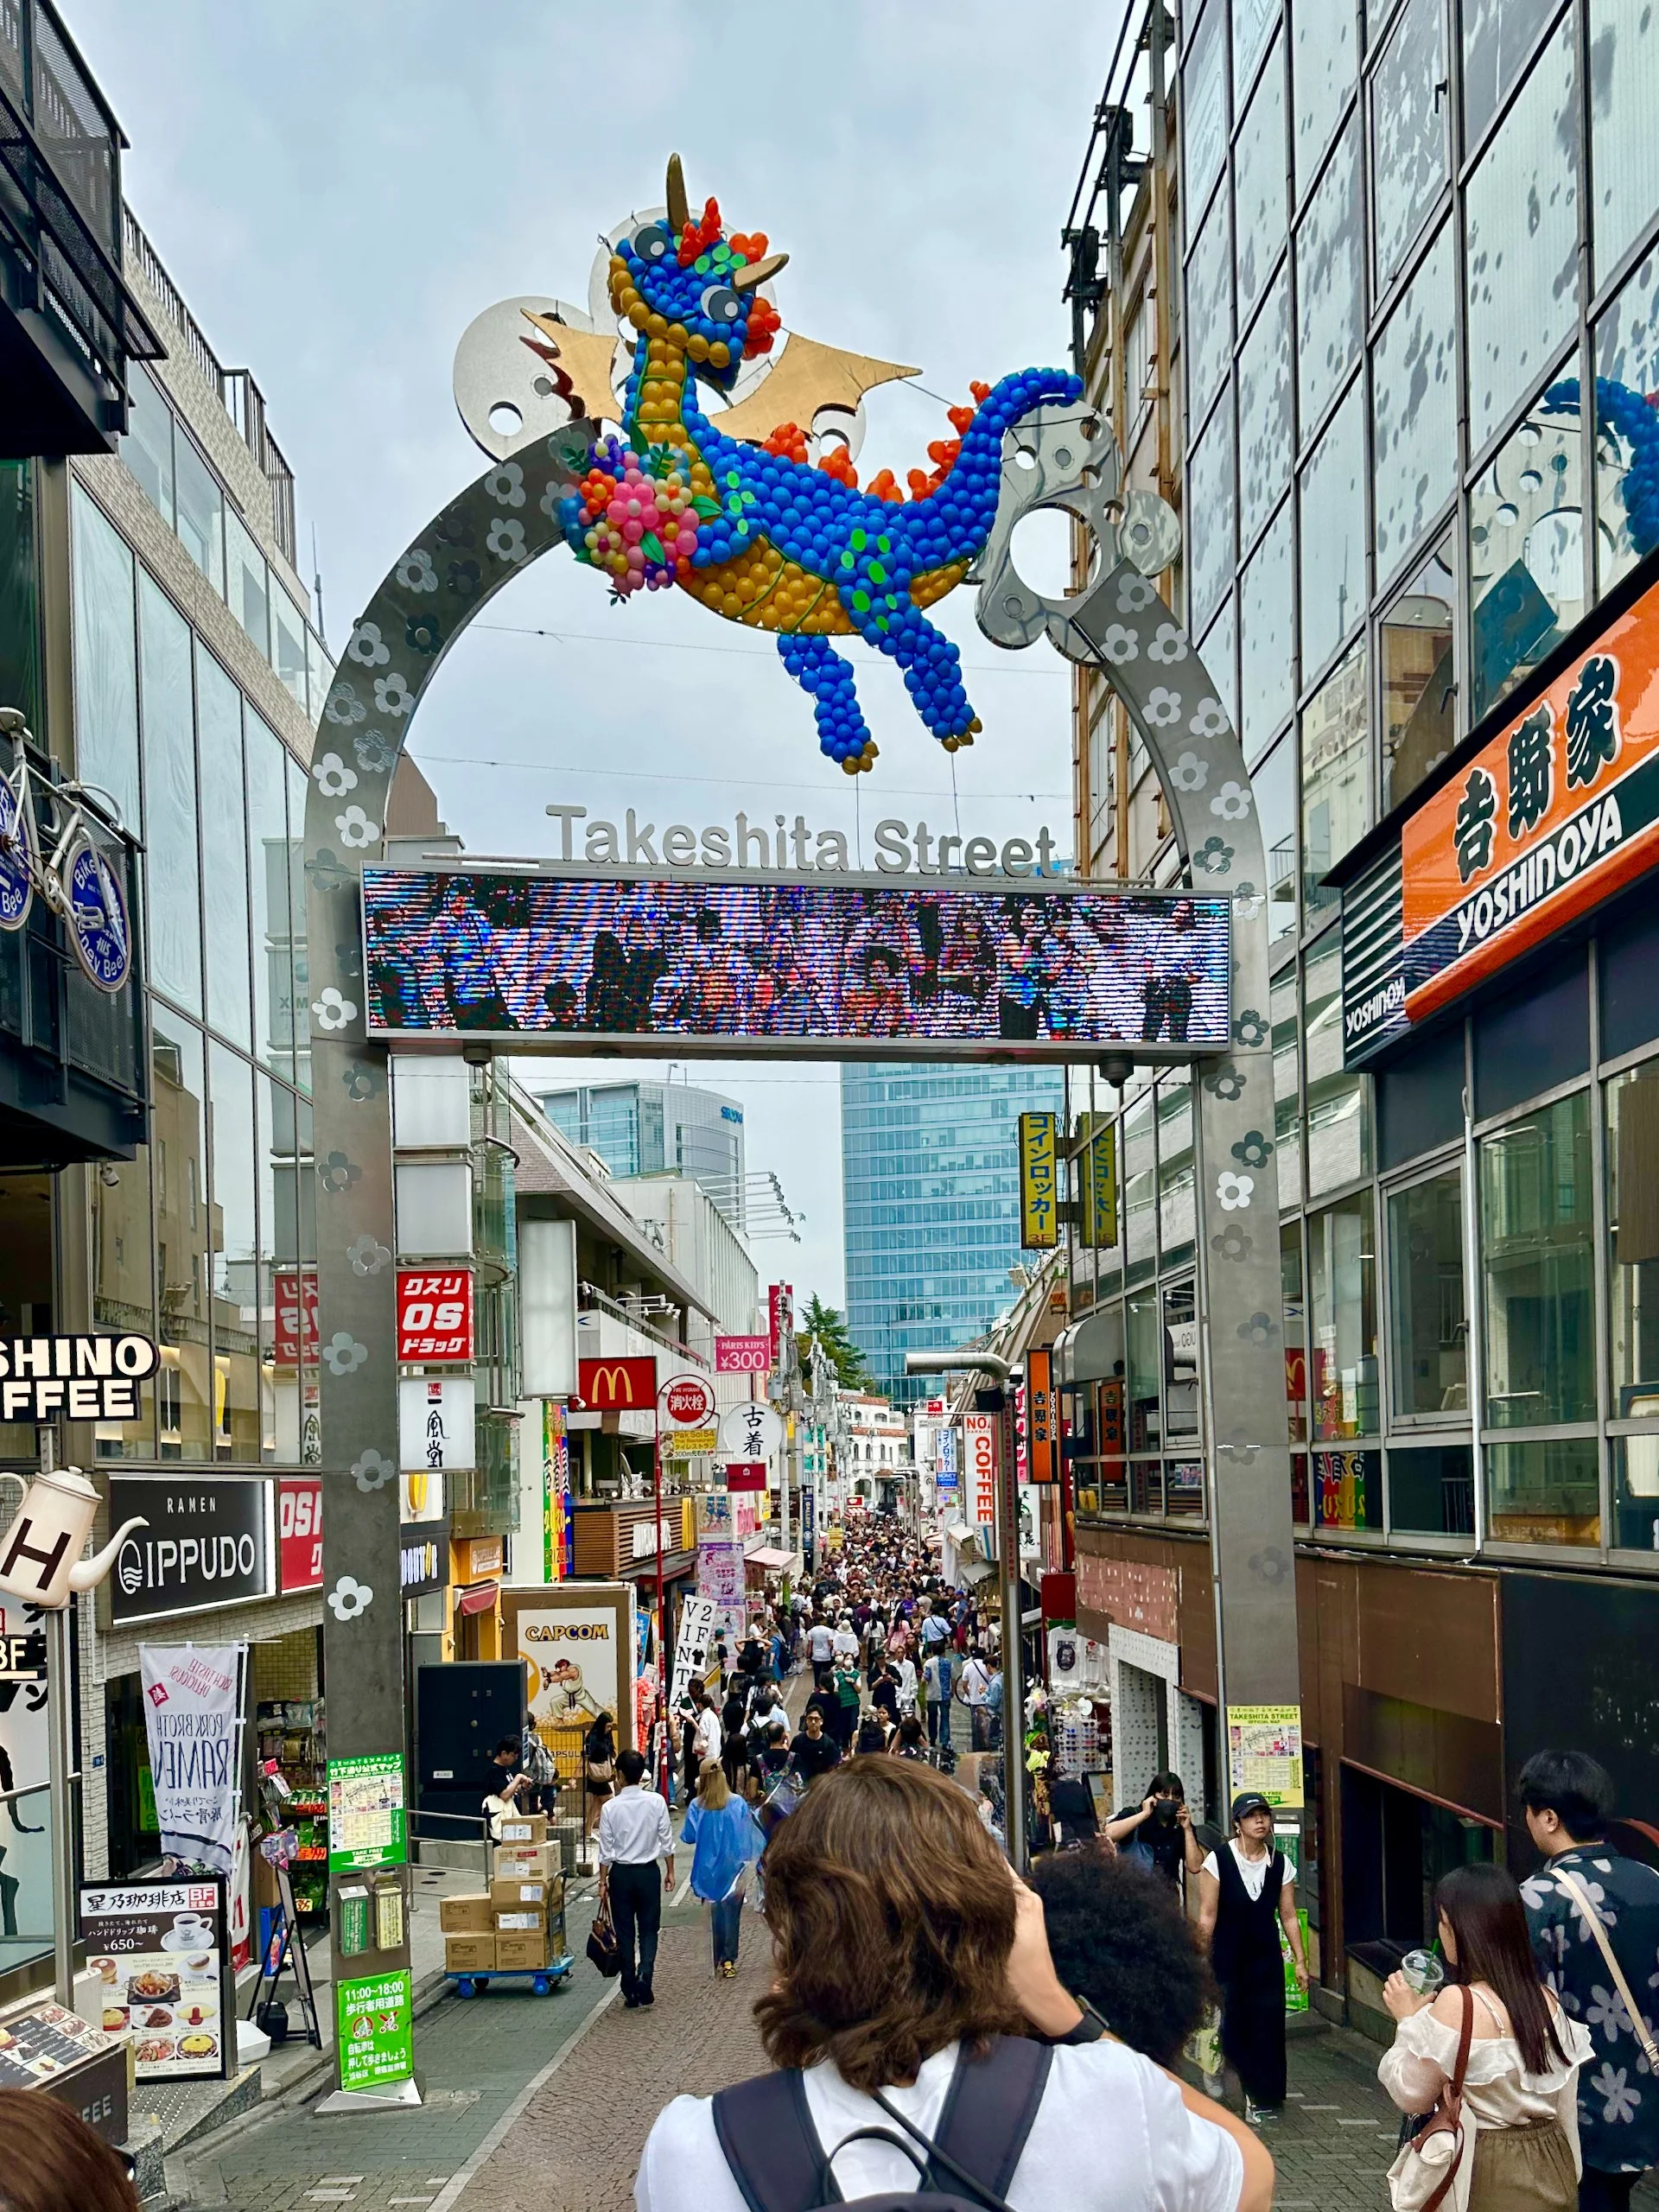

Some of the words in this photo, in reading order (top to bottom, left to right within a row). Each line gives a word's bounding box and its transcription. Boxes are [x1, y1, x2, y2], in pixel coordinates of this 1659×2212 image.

[1454, 653, 1622, 885] 吉野家
[545, 804, 849, 872] Takeshita
[874, 819, 1058, 880] Street
[1457, 793, 1624, 953] YOSHINOYA
[1027, 1116, 1052, 1230] コインロッカー
[404, 1277, 462, 1296] クスリ
[402, 1302, 465, 1331] OS
[402, 1337, 467, 1354] ドラッグ
[721, 1351, 765, 1370] ¥300
[670, 1395, 704, 1411] 消火栓
[1033, 1390, 1047, 1442] 吉野家
[426, 1398, 450, 1468] 一風堂
[742, 1406, 765, 1457] 古着
[976, 1436, 994, 1522] COFFEE
[167, 1497, 217, 1513] RAMEN
[1, 1517, 72, 1592] H
[525, 1624, 609, 1642] CAPCOM
[86, 1889, 188, 1912] 星乃珈琲店
[190, 1888, 213, 1901] BF
[346, 1994, 404, 2017] 歩行者用道路
[347, 2048, 406, 2070] 押して歩きましょう
[77, 2094, 112, 2124] FEE
